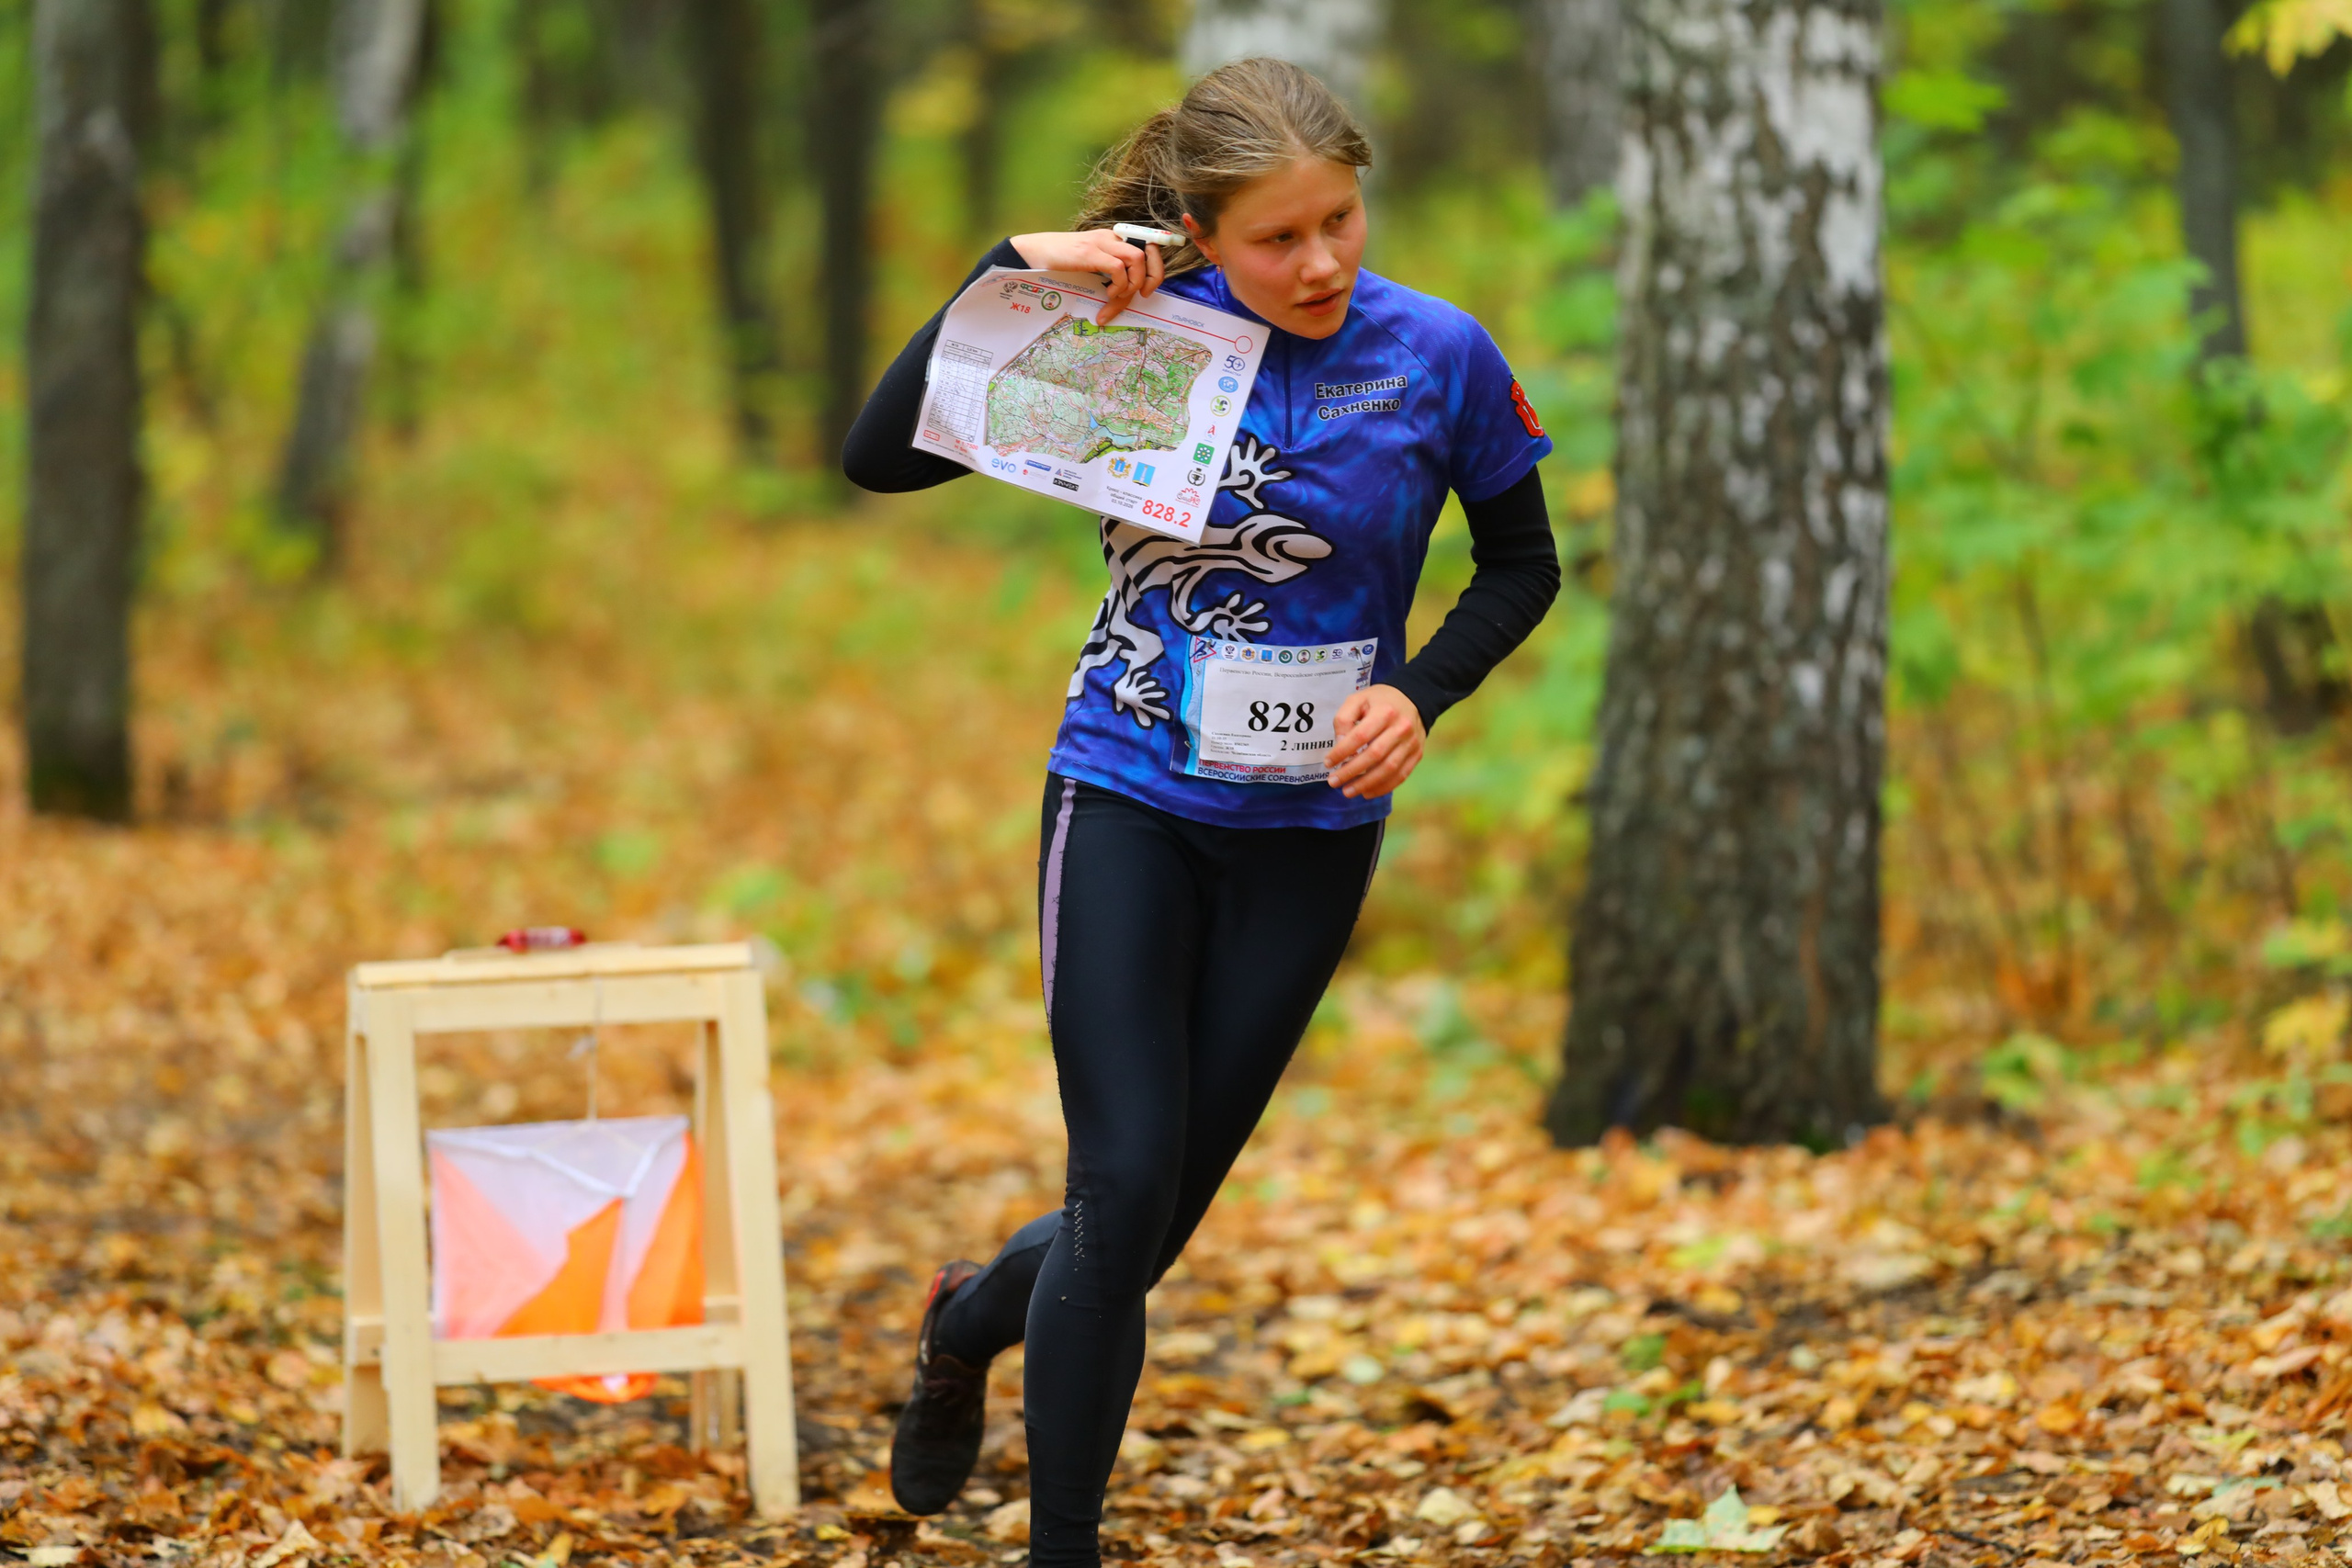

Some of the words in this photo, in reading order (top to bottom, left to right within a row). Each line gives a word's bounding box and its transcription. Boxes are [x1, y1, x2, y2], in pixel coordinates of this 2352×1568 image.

[1010, 302, 1031, 313] Ж18
[1315, 375, 1408, 400] Екатерина
[1317, 398, 1401, 421] Сахненко
[991, 457, 1016, 473] evo
[1142, 500, 1191, 527] 828.2
[1248, 700, 1315, 733] 828
[1280, 740, 1287, 751] 2
[1291, 739, 1333, 751] линия
[1199, 759, 1250, 773] ПЕРВЕНСТВО
[1252, 766, 1285, 774] РОССИИ
[1268, 772, 1329, 784] СОРЕВНОВАНИЯ
